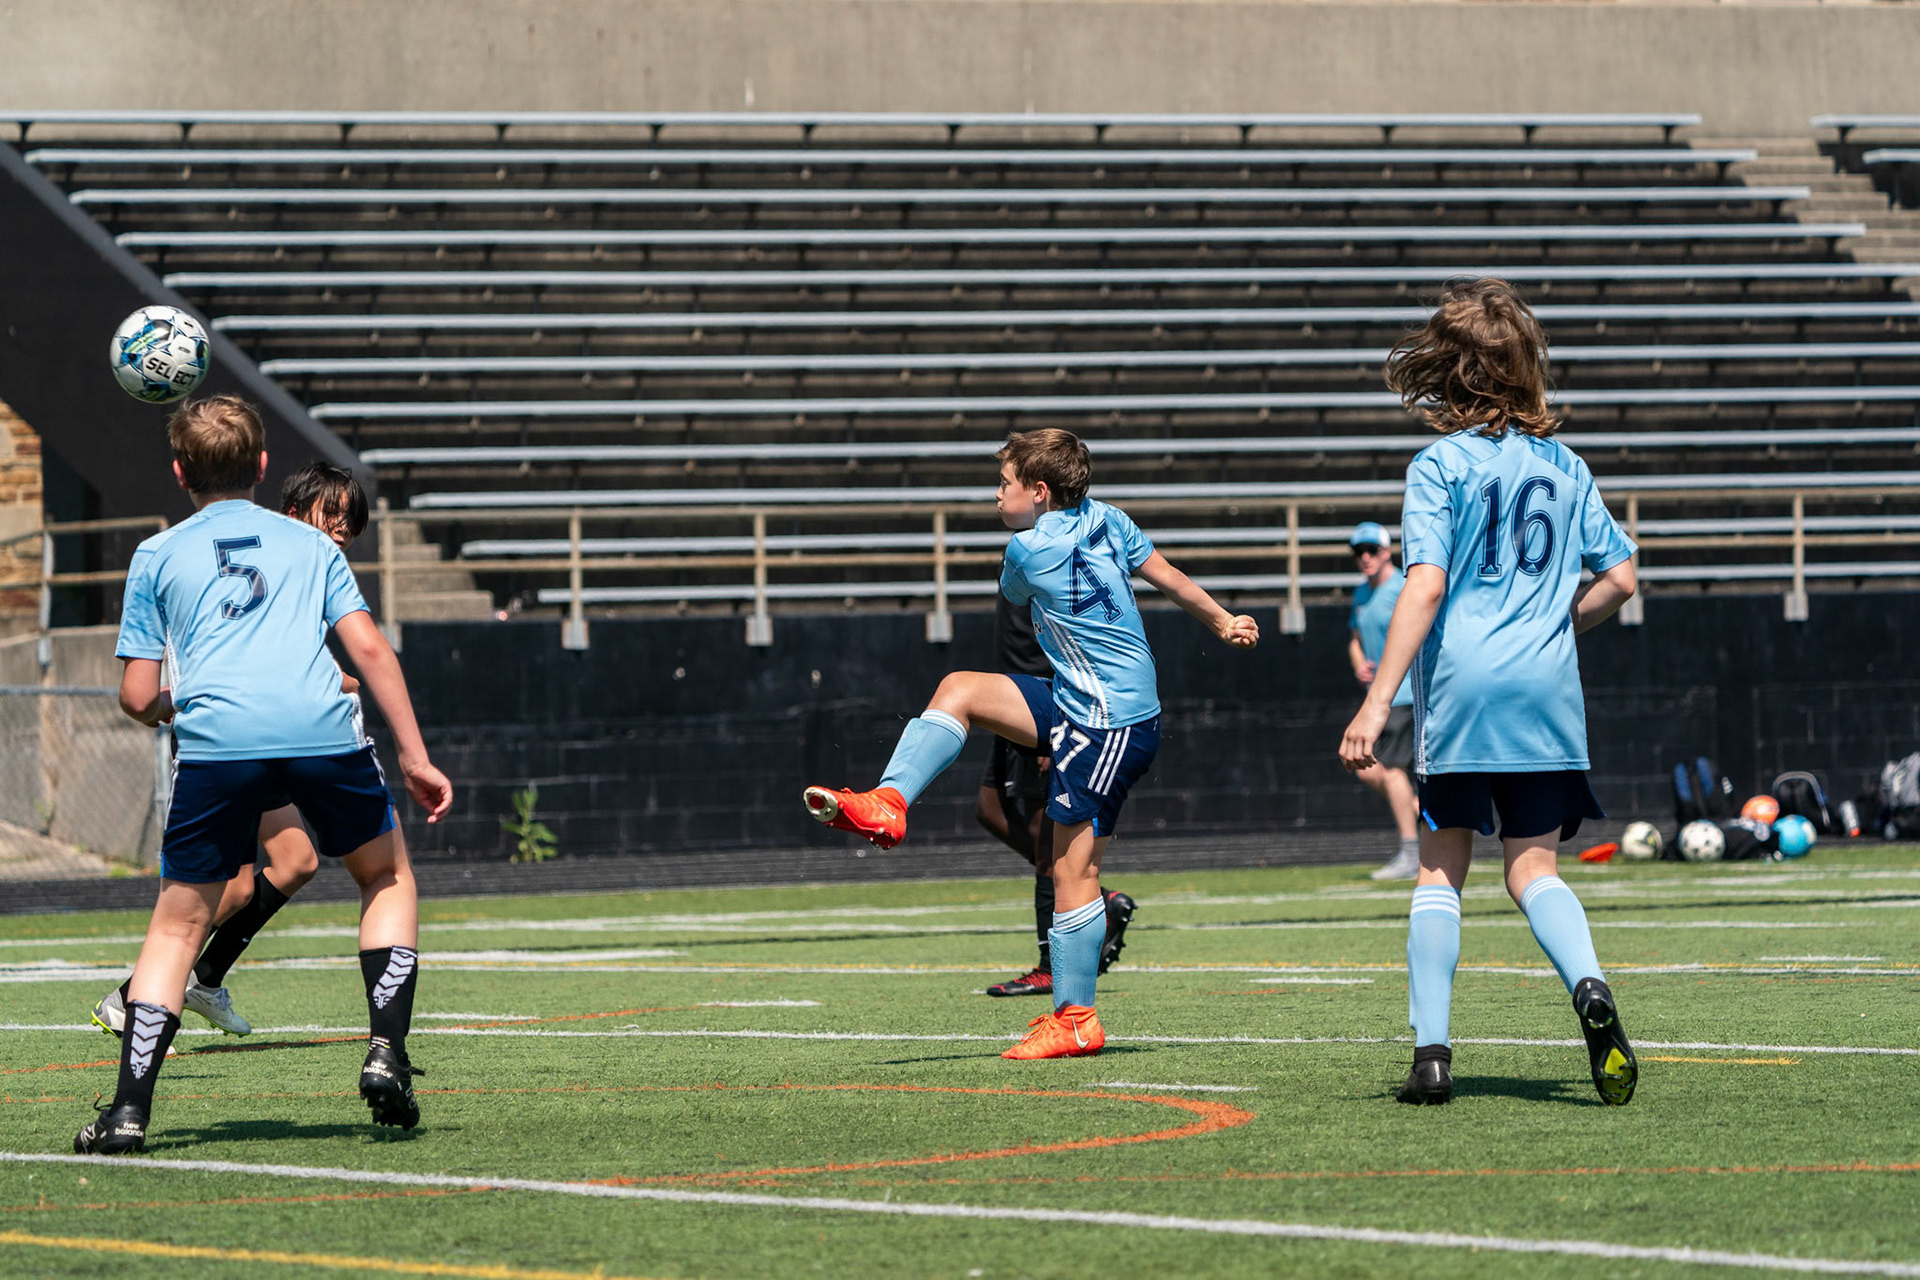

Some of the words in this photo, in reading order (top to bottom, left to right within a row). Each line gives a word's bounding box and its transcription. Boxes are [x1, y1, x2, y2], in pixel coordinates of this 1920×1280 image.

[146, 358, 197, 386] SELECT
[1478, 476, 1556, 577] 16
[213, 535, 268, 620] 5
[363, 1066, 392, 1079] balance
[371, 1061, 387, 1069] new
[123, 1122, 140, 1130] new
